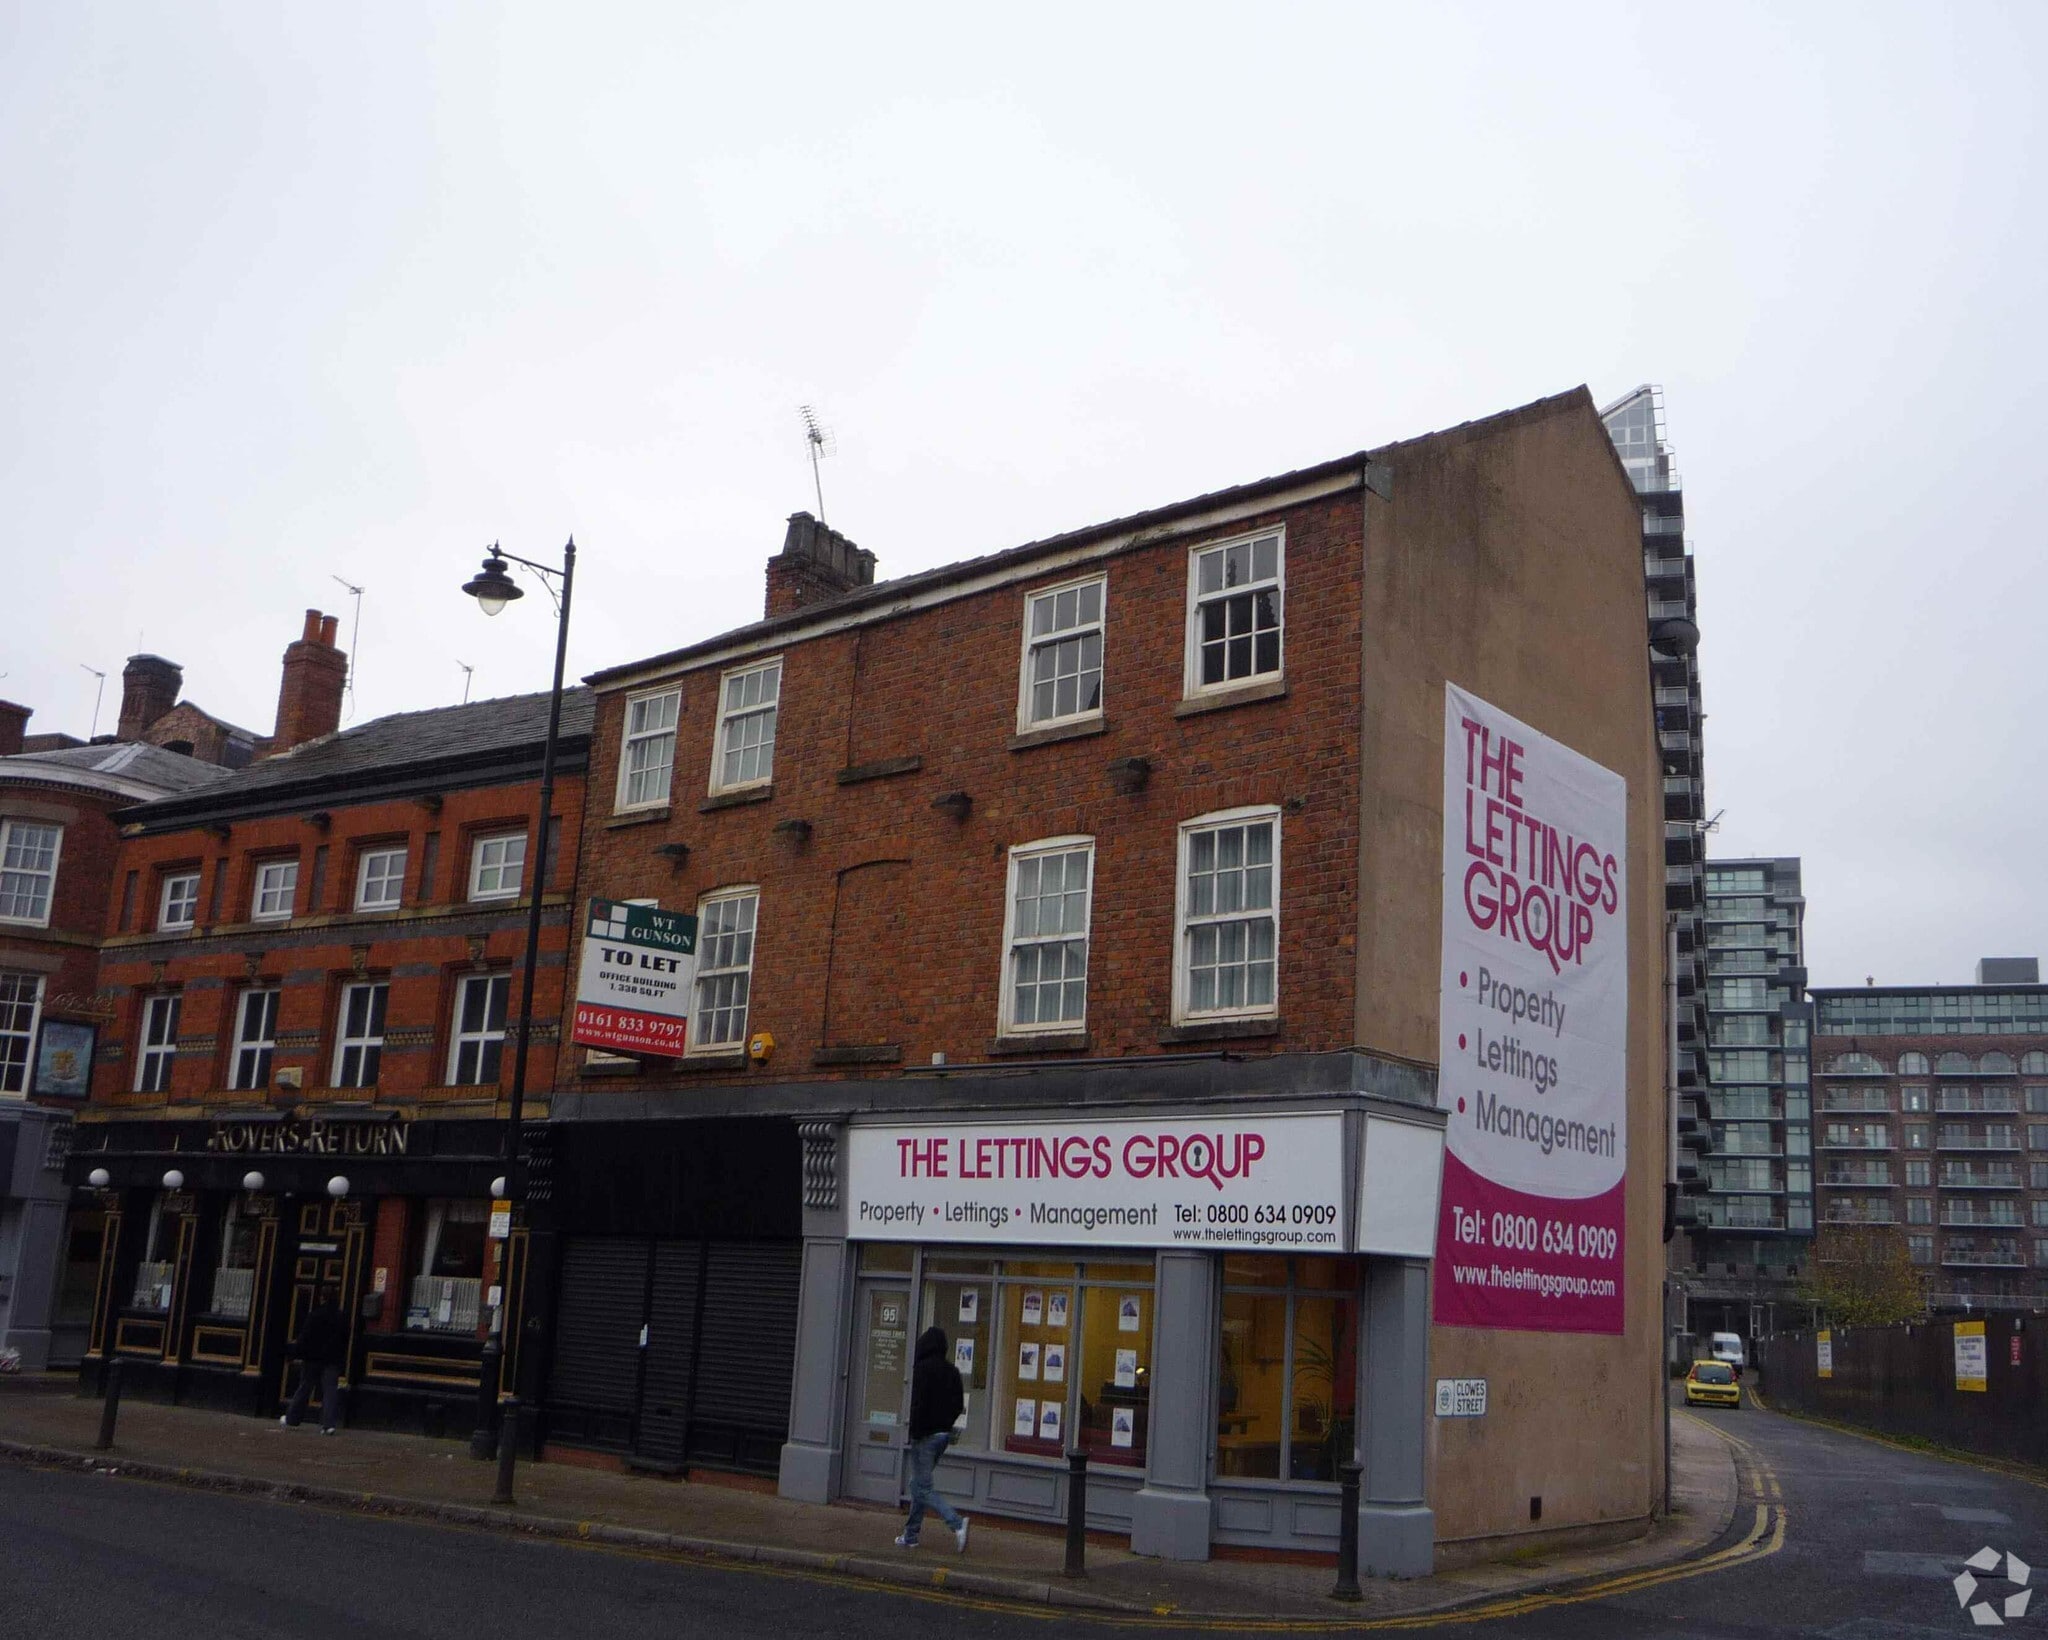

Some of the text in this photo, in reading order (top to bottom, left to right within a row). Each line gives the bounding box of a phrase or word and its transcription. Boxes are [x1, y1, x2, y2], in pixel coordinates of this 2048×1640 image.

[1462, 716, 1524, 808] THE
[1466, 788, 1617, 915] LETTINGS
[652, 916, 676, 930] WT
[1464, 861, 1593, 975] GROUP
[631, 926, 691, 947] GUNSON
[601, 947, 681, 974] TO LET
[599, 971, 677, 990] OFFICE BUILDING
[1478, 966, 1566, 1037] Property
[577, 1027, 682, 1049] www.wtgunson.co.uk
[578, 1010, 683, 1038] 0161 833 9797
[1477, 1028, 1558, 1094] Lettings
[309, 1119, 410, 1154] RETURN
[1476, 1090, 1615, 1158] Management
[897, 1133, 1265, 1192] THE LETTINGS GROUP
[860, 1200, 1158, 1230] Property Lettings Management
[1174, 1204, 1337, 1225] Tel: 0800 634 0909
[1173, 1228, 1336, 1245] www.thelettingsgroup.com
[1453, 1206, 1617, 1260] Tel: 0800 634 0909
[1453, 1263, 1615, 1298] www.thelettingsgroup.com
[883, 1308, 897, 1322] 95
[1456, 1382, 1485, 1397] CLOWES
[1456, 1398, 1484, 1413] STREET
